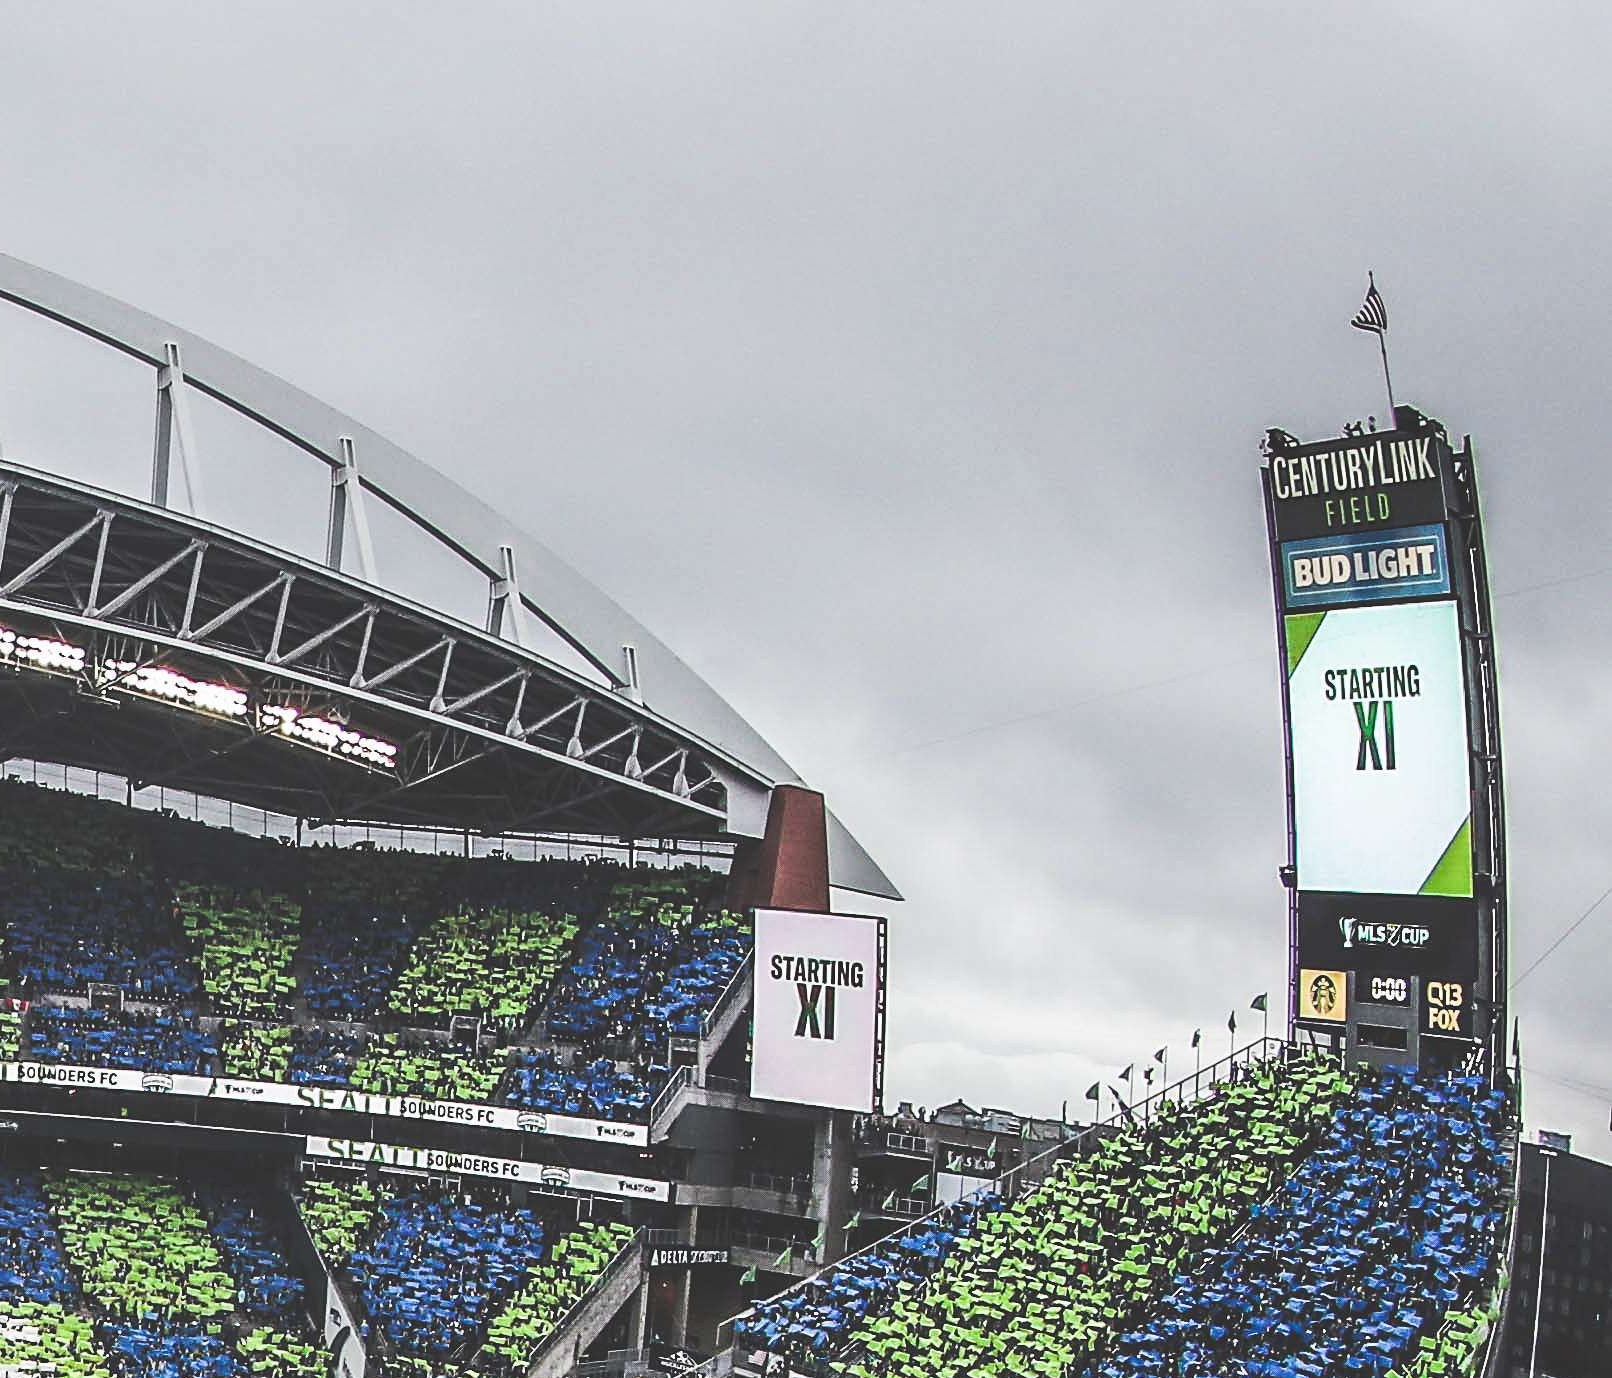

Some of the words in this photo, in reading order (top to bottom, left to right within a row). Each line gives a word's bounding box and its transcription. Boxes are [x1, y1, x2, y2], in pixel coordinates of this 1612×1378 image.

[1326, 493, 1390, 526] FIELD
[1294, 552, 1350, 587] BUD
[1354, 545, 1435, 580] LIGHT
[1325, 665, 1420, 700] STARTING
[1353, 701, 1396, 770] XI
[1357, 925, 1386, 945] MLS
[1401, 927, 1429, 946] CUP
[771, 954, 864, 988] STARTING
[1371, 977, 1407, 1001] 0:00
[1427, 982, 1462, 1007] Q13
[794, 984, 836, 1041] XI
[1429, 1008, 1461, 1032] FOX
[18, 1064, 96, 1084] SOUNDERS
[100, 1073, 118, 1086] FC
[399, 1099, 474, 1121] SOUNDERS
[477, 1109, 495, 1123] FC
[427, 1152, 499, 1174] SOUNDERS
[502, 1162, 520, 1177] FC
[660, 1250, 688, 1264] DELTA
